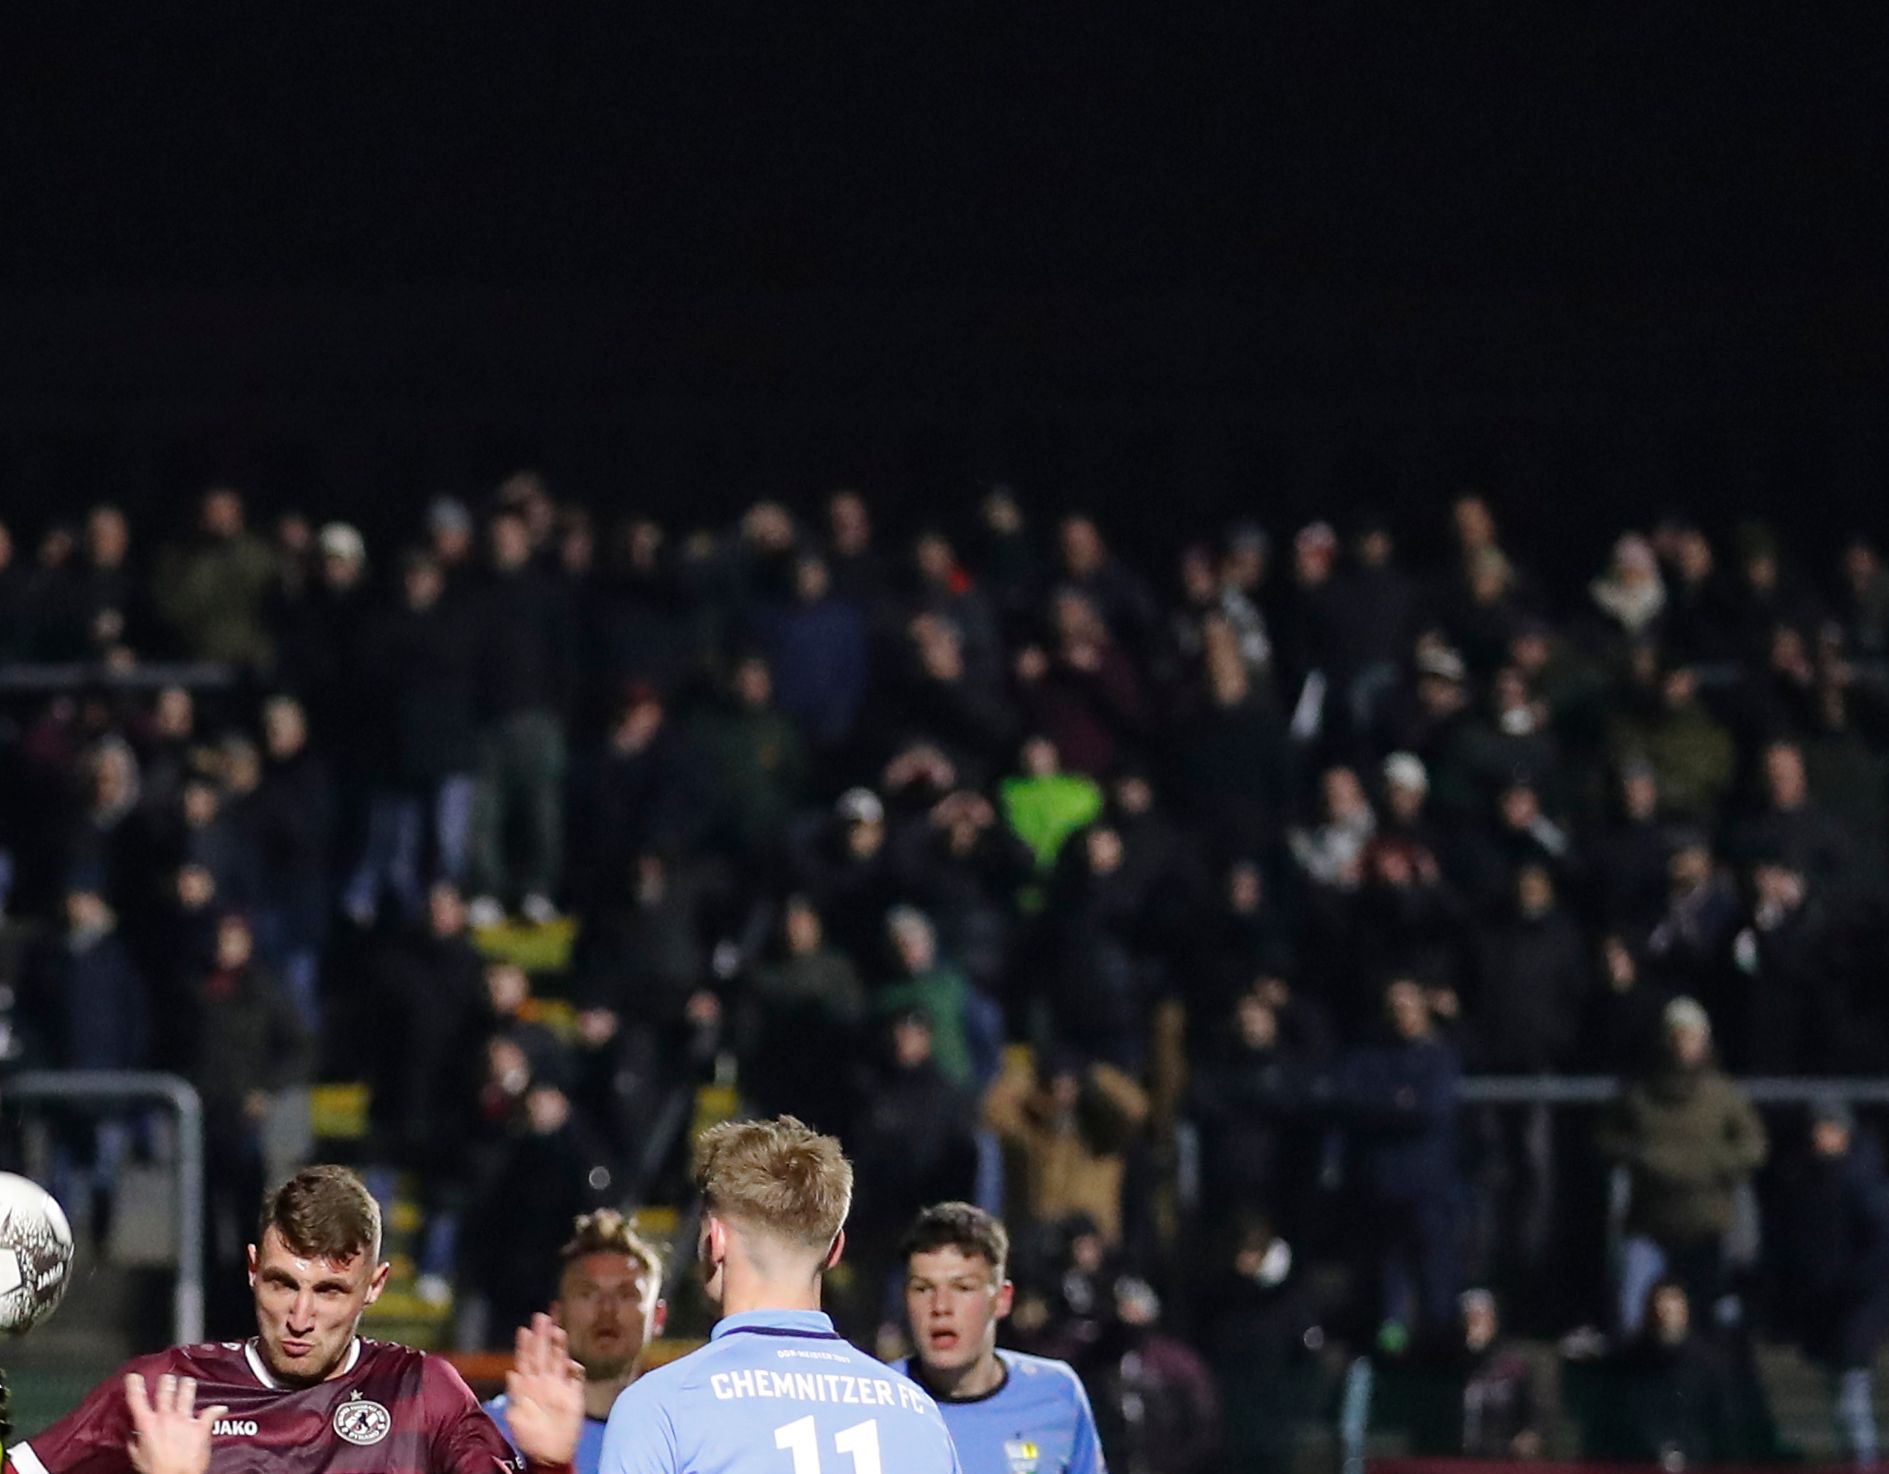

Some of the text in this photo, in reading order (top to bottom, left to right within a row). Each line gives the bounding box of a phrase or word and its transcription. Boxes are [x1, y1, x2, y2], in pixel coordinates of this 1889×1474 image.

[710, 1369, 925, 1415] CHEMNITZER FC
[212, 1420, 258, 1436] JAKO
